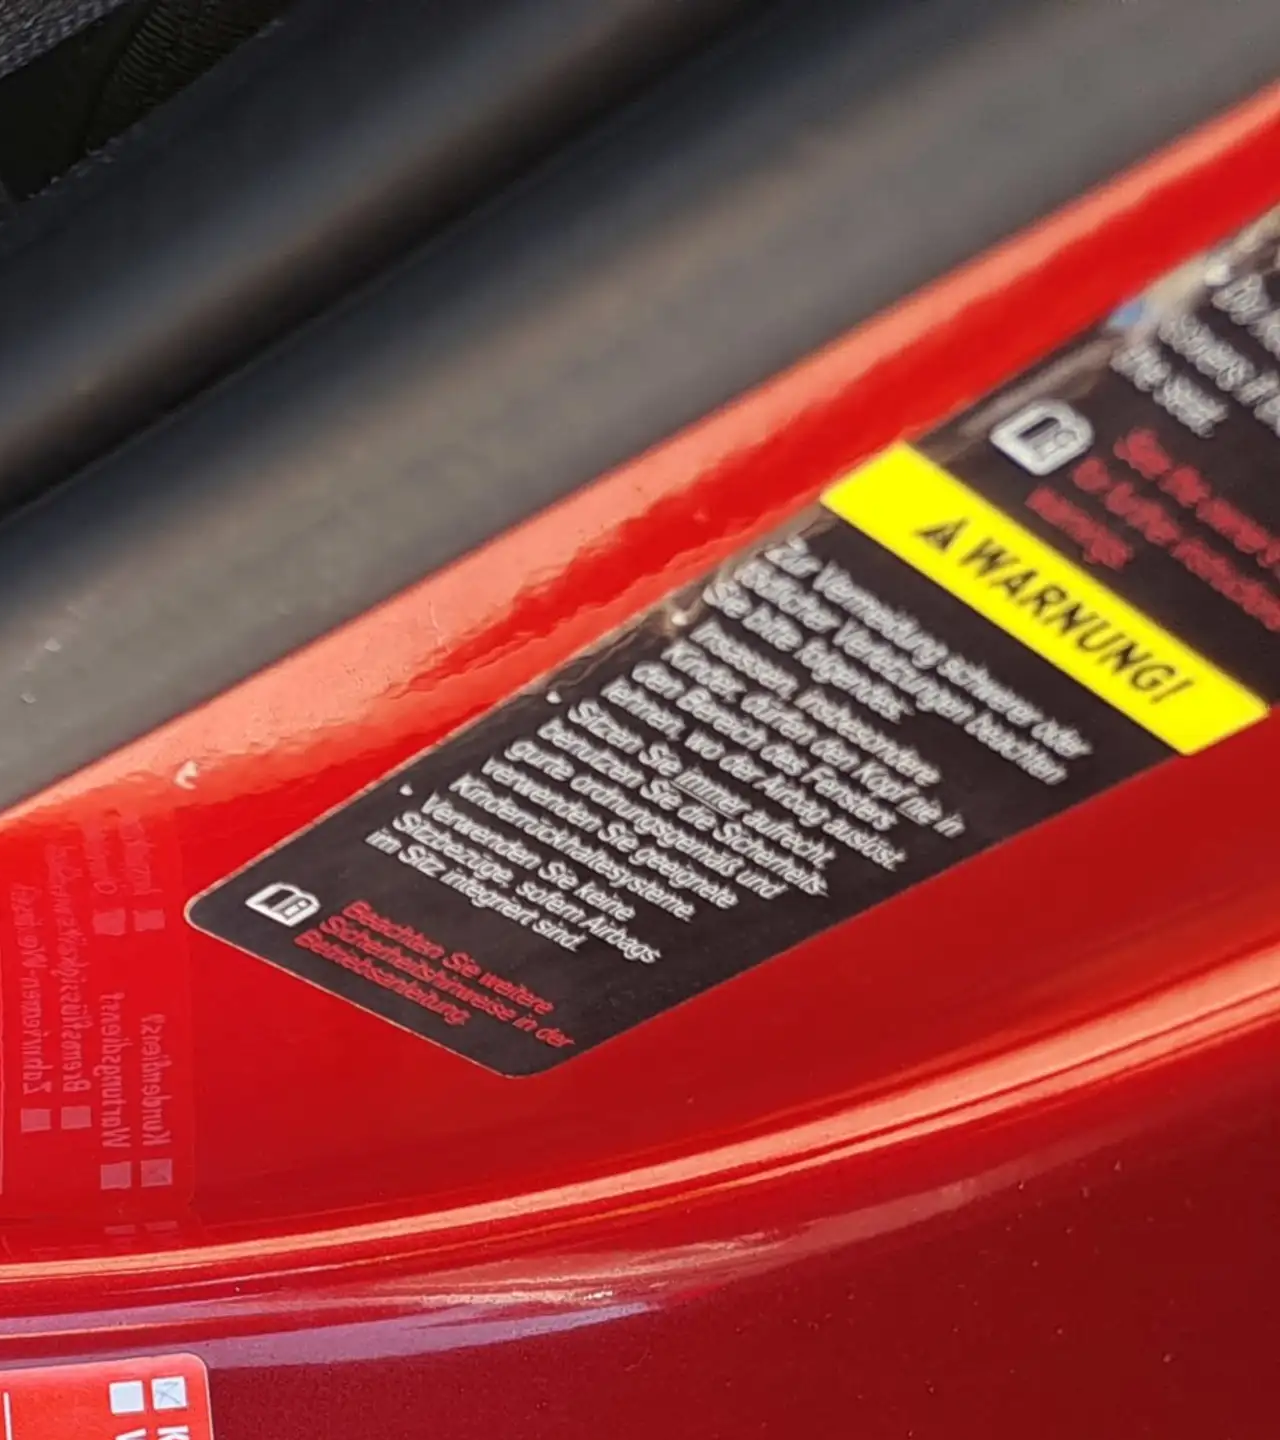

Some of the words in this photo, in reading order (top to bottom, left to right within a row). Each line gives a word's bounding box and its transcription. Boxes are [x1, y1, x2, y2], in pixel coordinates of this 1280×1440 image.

[744, 608, 801, 650] bitte
[809, 569, 946, 667] Vermeidung
[959, 537, 1195, 705] WARNUNG!
[539, 720, 643, 786] benutzen
[640, 780, 682, 809] Sie
[678, 802, 725, 830] die
[714, 824, 825, 893] Sicherheits-
[569, 702, 643, 752] Sitzen
[639, 745, 681, 776] Sie
[674, 769, 750, 814] immer
[744, 811, 833, 867] aufrecht,
[633, 665, 683, 698] den
[678, 689, 766, 748] Bereich
[761, 744, 807, 775] des
[803, 767, 895, 829] Fensters
[685, 733, 724, 759] wo
[720, 755, 763, 780] der
[755, 776, 829, 826] Airbag
[824, 820, 904, 868] auslöst.
[742, 696, 816, 743] dürfen
[811, 739, 858, 770] den
[853, 763, 916, 800] Kopf
[902, 797, 941, 823] nie
[935, 815, 963, 835] in
[797, 692, 938, 784] insbesondere
[967, 715, 1063, 781] beachten
[394, 813, 512, 886] Sitzbezüge,
[517, 882, 584, 922] sofern
[581, 917, 659, 962] Airbags
[423, 795, 540, 868] Verwenden
[539, 862, 577, 889] Sie
[575, 882, 634, 920] keine
[452, 776, 692, 917] Kinderrückhaltesysteme.
[483, 760, 601, 830] verwenden
[598, 823, 641, 852] Sie
[630, 845, 736, 907] geeignete
[505, 741, 573, 780] gurte
[572, 777, 742, 875] ordnungsgemäß
[736, 871, 786, 898] und
[366, 829, 401, 853] im
[399, 845, 445, 876] Sitz
[442, 869, 538, 924] integriert
[533, 920, 585, 950] sind.
[443, 951, 482, 979] Sie
[478, 972, 555, 1016] weitere
[512, 1013, 538, 1034] in
[535, 1026, 575, 1048] der
